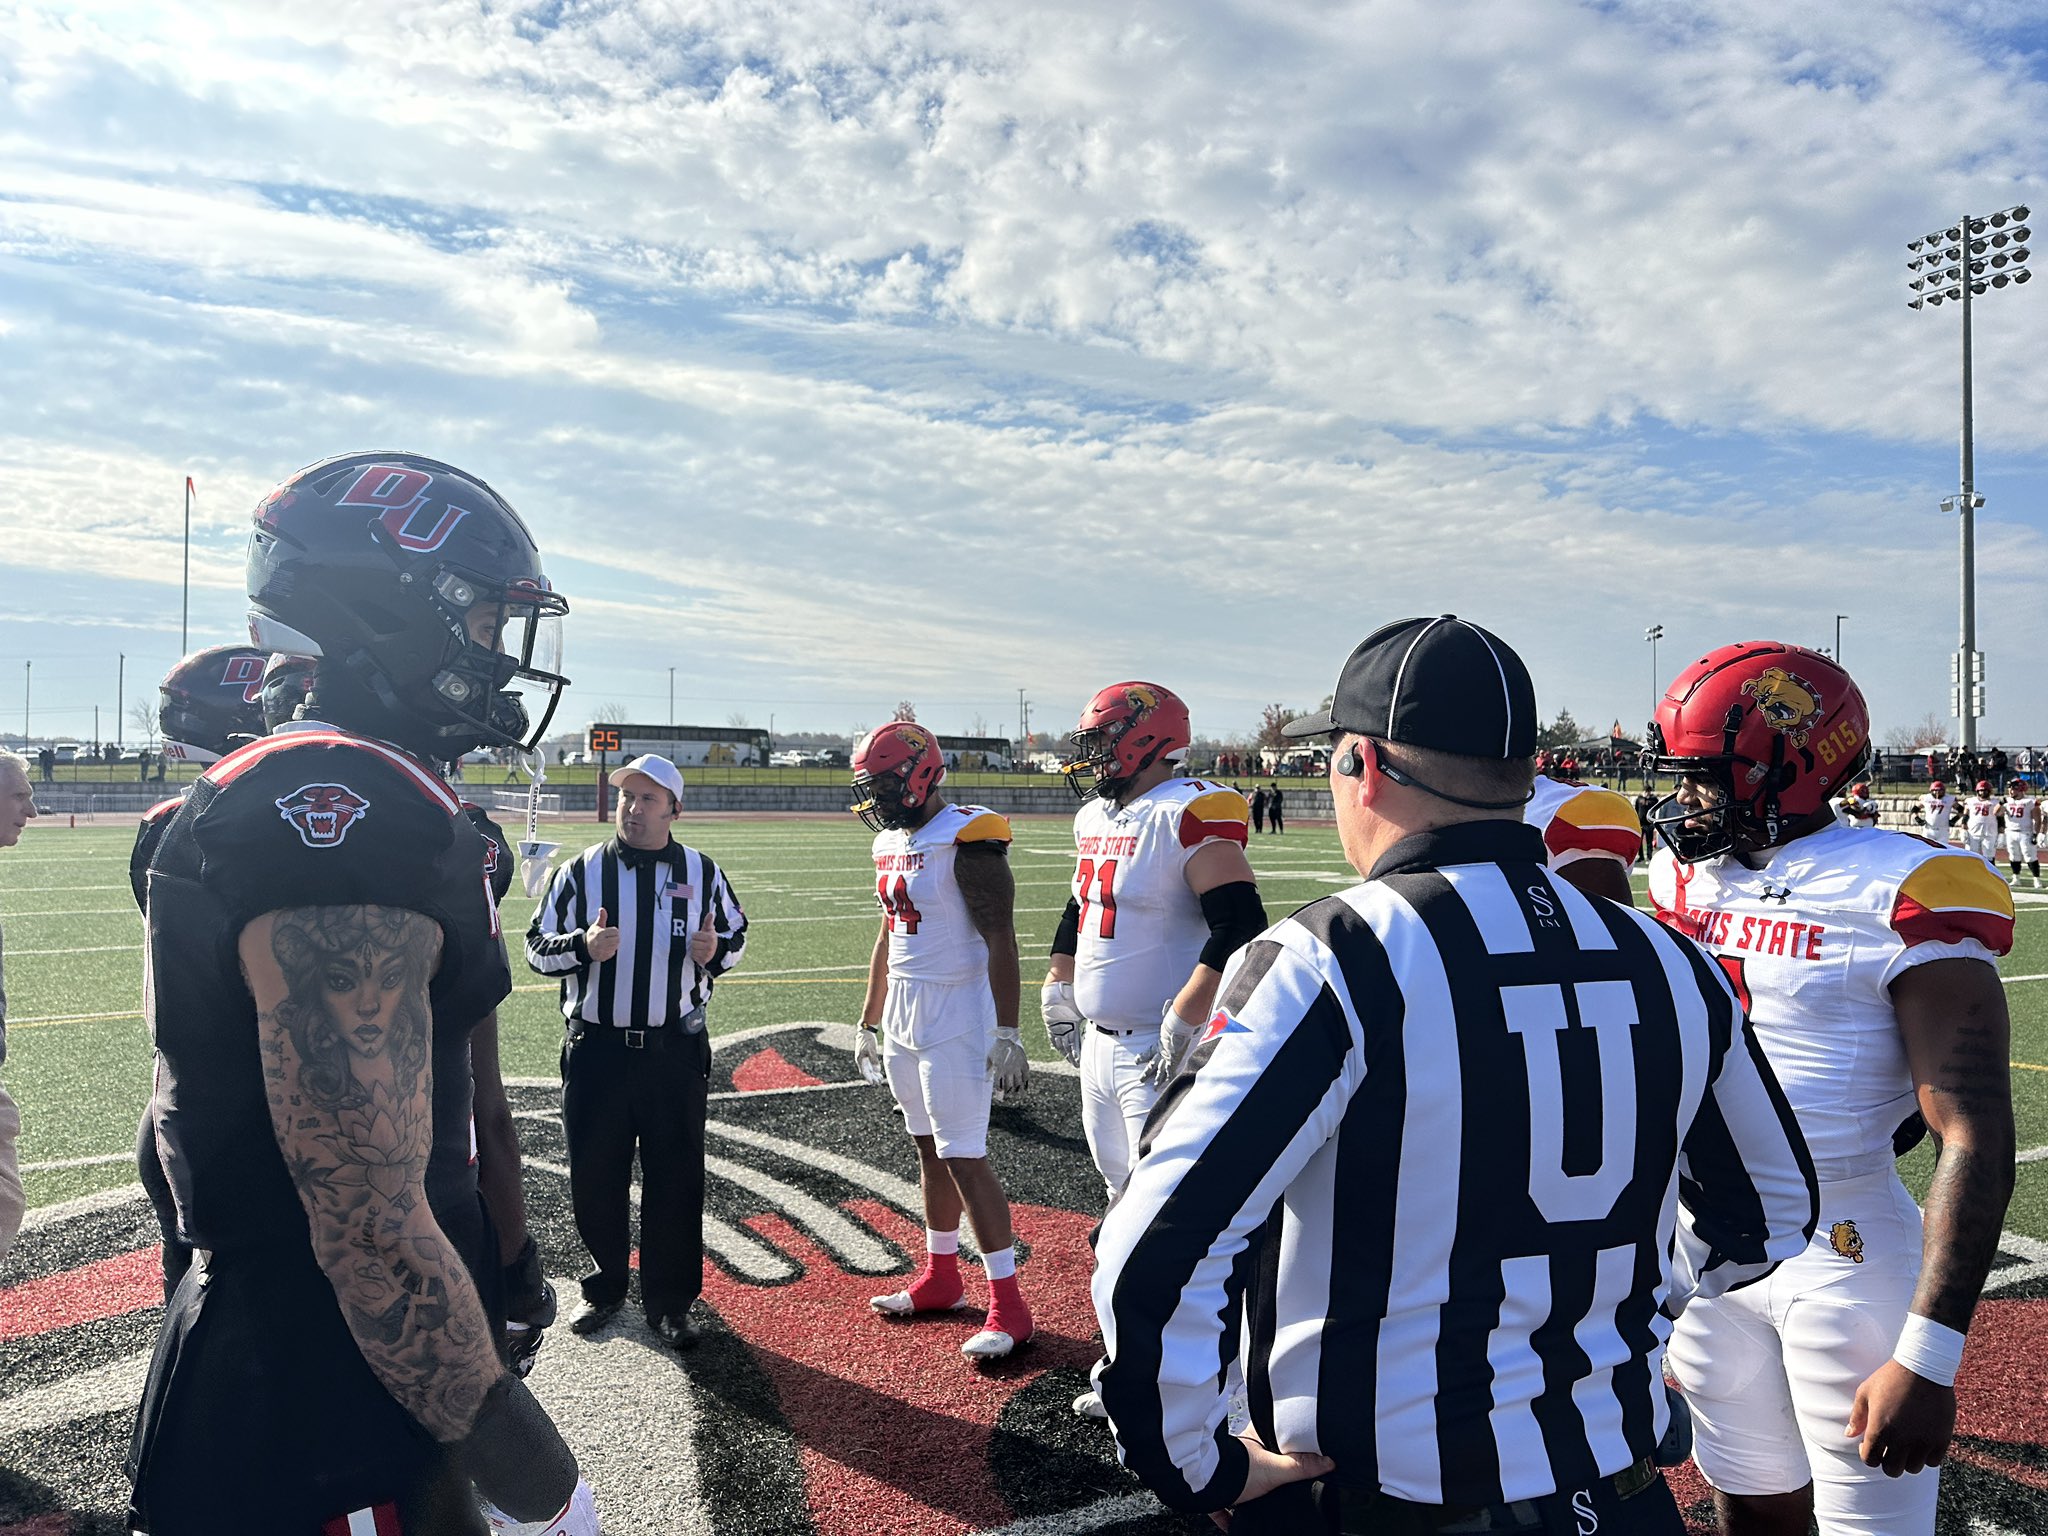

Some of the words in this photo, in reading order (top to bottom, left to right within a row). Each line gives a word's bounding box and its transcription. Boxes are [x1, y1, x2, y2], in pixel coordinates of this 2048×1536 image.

[335, 465, 471, 553] DU
[593, 731, 619, 750] 25
[1817, 720, 1858, 766] 815
[896, 853, 924, 871] STATE
[1102, 837, 1137, 856] STATE
[878, 874, 922, 935] 14
[1077, 858, 1118, 939] 71
[672, 918, 686, 937] R
[1539, 919, 1560, 928] USA
[1736, 915, 1825, 961] STATE
[1499, 980, 1640, 1223] U
